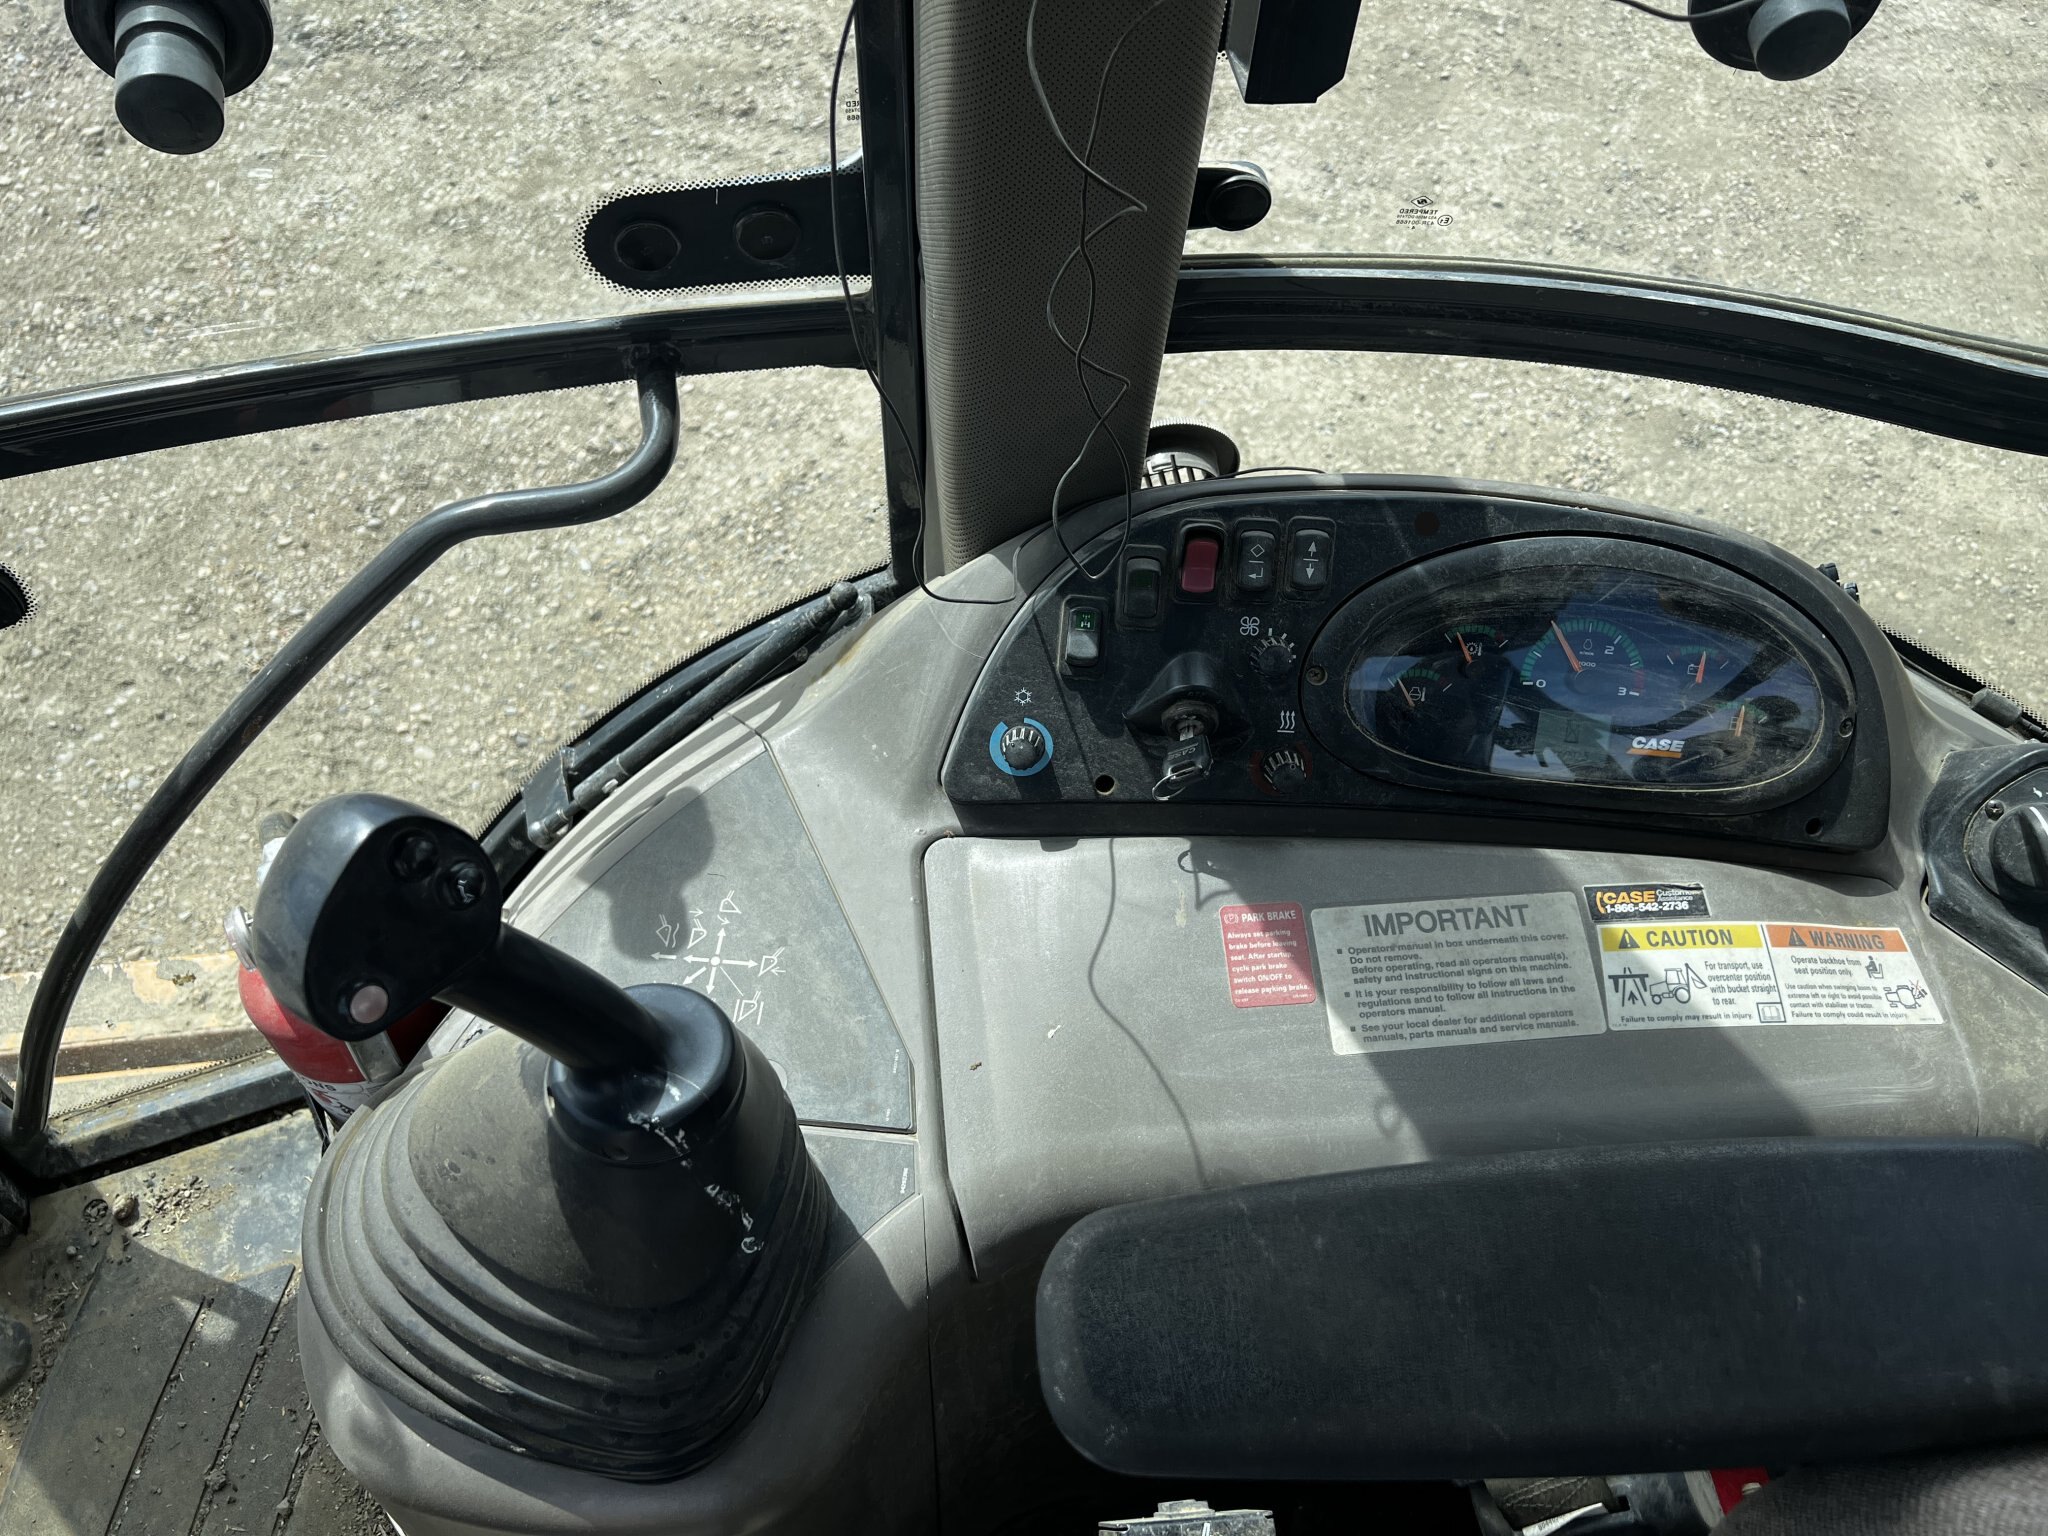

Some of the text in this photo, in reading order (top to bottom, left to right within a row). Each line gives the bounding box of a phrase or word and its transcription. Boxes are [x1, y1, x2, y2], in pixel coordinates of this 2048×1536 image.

[1605, 646, 1614, 655] 2
[1618, 687, 1626, 696] 3
[1632, 737, 1685, 752] CASE
[1603, 891, 1655, 904] CASE
[1606, 901, 1688, 913] 1-866-542-2736
[1242, 912, 1264, 922] PARK
[1267, 910, 1296, 920] BRAKE
[1363, 904, 1529, 937] IMPORTANT
[1228, 931, 1251, 939] Always
[1646, 929, 1733, 947] CAUTION
[1809, 930, 1885, 950] WARNING
[1348, 933, 1568, 955] Operators manual in box underneath this cover.
[1352, 952, 1568, 974] Before operating, read all operators manual(s).
[1366, 955, 1381, 963] not
[1384, 953, 1422, 962] remove.
[1791, 956, 1861, 966] Operate backhoe from
[1705, 961, 1716, 970] For
[1718, 962, 1750, 971] transport,
[1794, 967, 1853, 977] seat position only.
[1258, 973, 1282, 982] ON/OFF
[1354, 962, 1572, 984] safety and instructional signs on this machine.
[1708, 972, 1771, 982] overcenter position
[1261, 985, 1287, 994] parking
[1355, 990, 1362, 998] It
[1365, 989, 1373, 997] is
[1375, 988, 1397, 999] your
[1400, 982, 1464, 996] responsibility
[1467, 982, 1476, 990] to
[1479, 980, 1507, 988] follow
[1509, 978, 1520, 986] all
[1522, 977, 1544, 985] laws
[1710, 984, 1776, 994] with bucket straight
[1358, 998, 1411, 1009] regulations
[1414, 995, 1432, 1003] and
[1434, 994, 1444, 1002] to
[1446, 992, 1475, 1001] follow
[1478, 991, 1488, 999] all
[1491, 987, 1547, 998] instructions
[1550, 986, 1558, 994] in
[1721, 997, 1736, 1005] rear.
[1359, 1004, 1446, 1019] operators manual.
[1823, 1011, 1845, 1019] comply
[1361, 1024, 1380, 1032] See
[1382, 1023, 1404, 1032] your
[1406, 1020, 1429, 1029] local
[1432, 1017, 1461, 1027] dealer
[1480, 1012, 1526, 1023] additional
[1529, 1010, 1573, 1020] operators
[1621, 1015, 1645, 1023] Failure
[1657, 1014, 1683, 1023] comply
[1685, 1014, 1700, 1022] may
[1732, 1013, 1753, 1021] injury.
[1363, 1019, 1579, 1043] manuals, parts manuals and service manuals.
